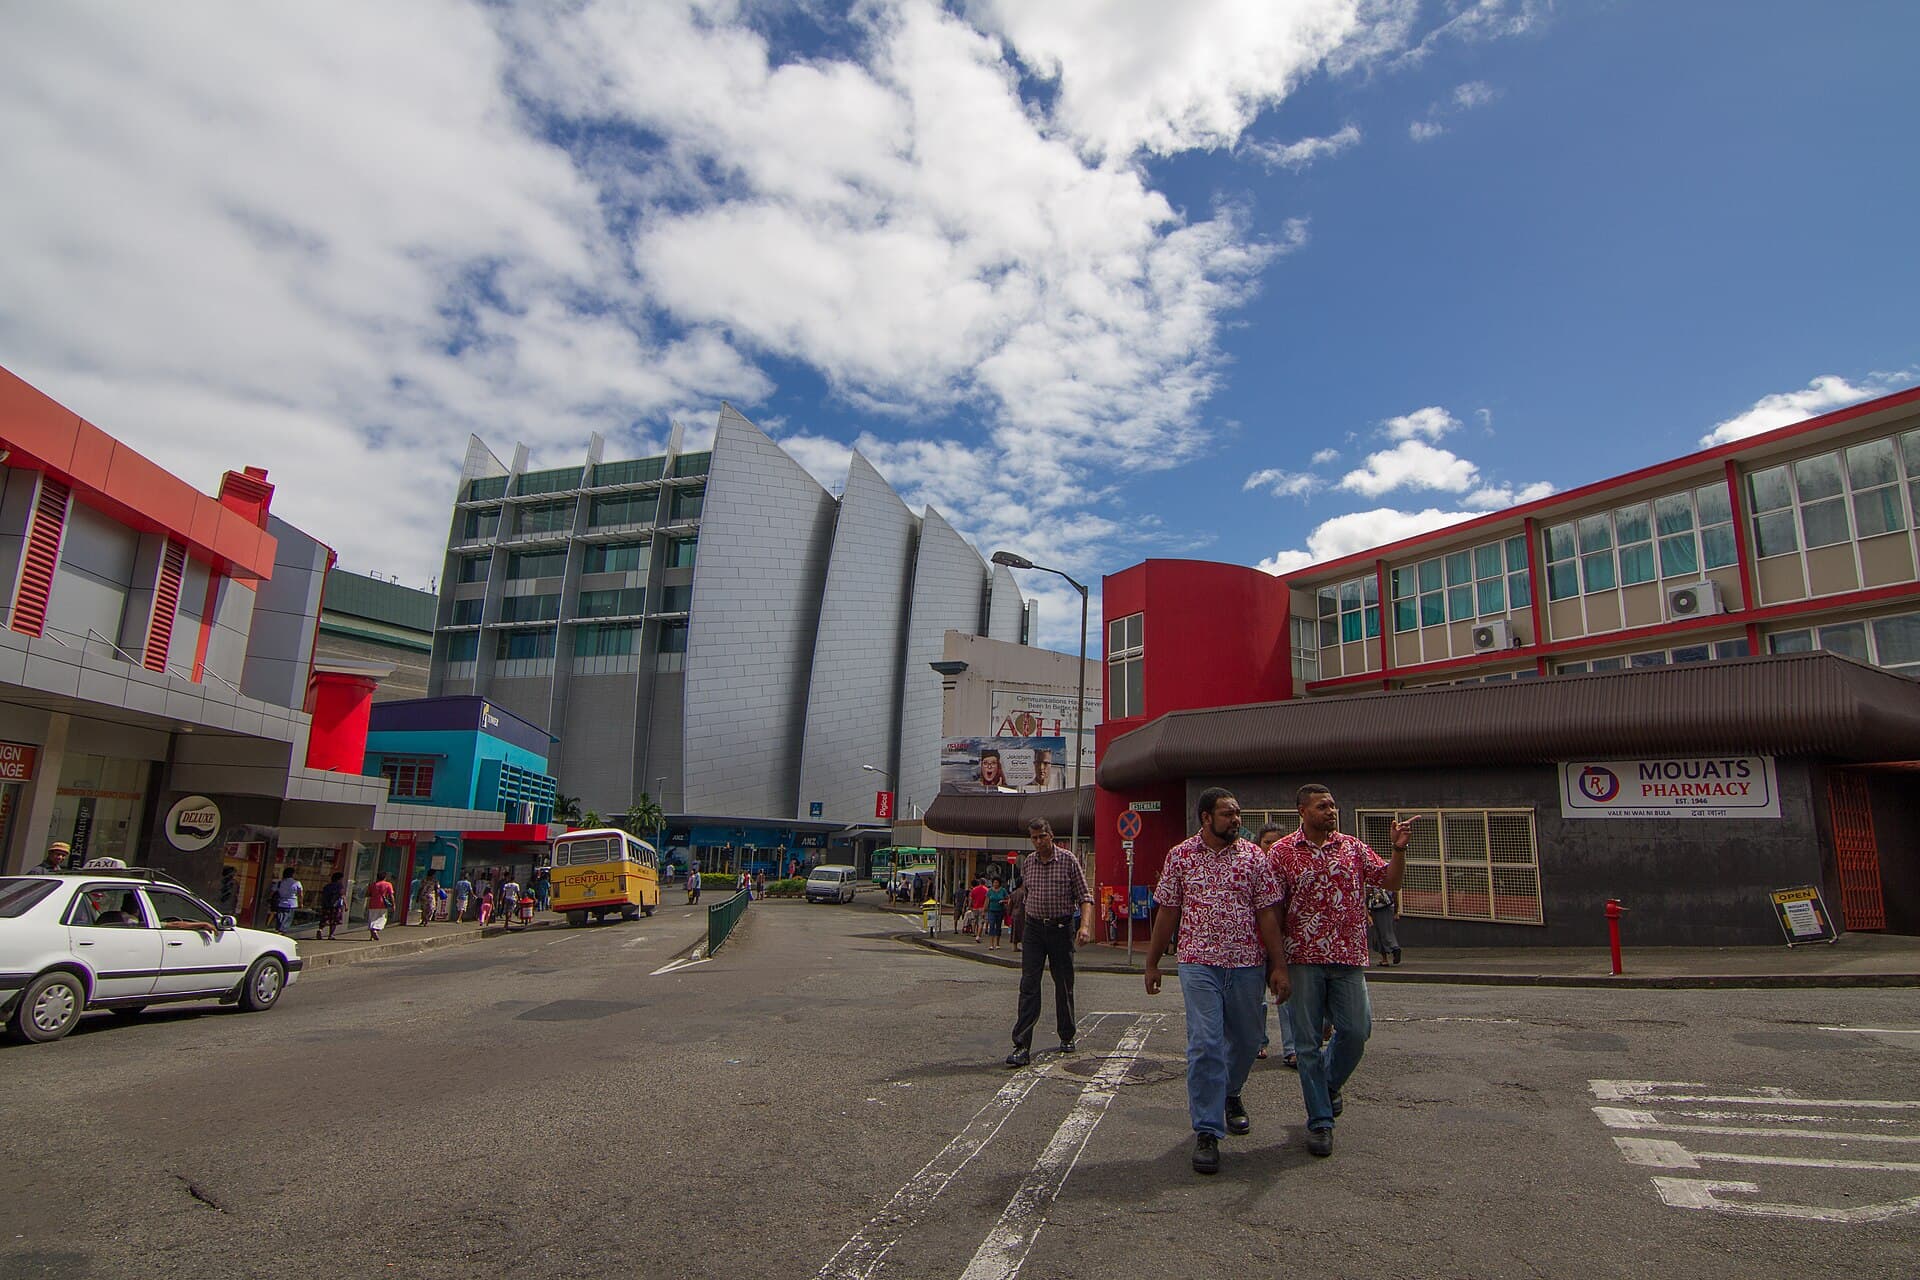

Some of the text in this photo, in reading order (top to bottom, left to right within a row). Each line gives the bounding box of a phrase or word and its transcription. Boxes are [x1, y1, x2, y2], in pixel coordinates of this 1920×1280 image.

[1016, 696, 1067, 706] Communications
[1639, 759, 1751, 780] MOUATS
[1642, 782, 1752, 797] PHARMACY
[182, 812, 216, 824] DELUXE
[88, 860, 114, 868] TAXI
[568, 874, 611, 885] CENTRAL
[1779, 892, 1811, 900] OPEN
